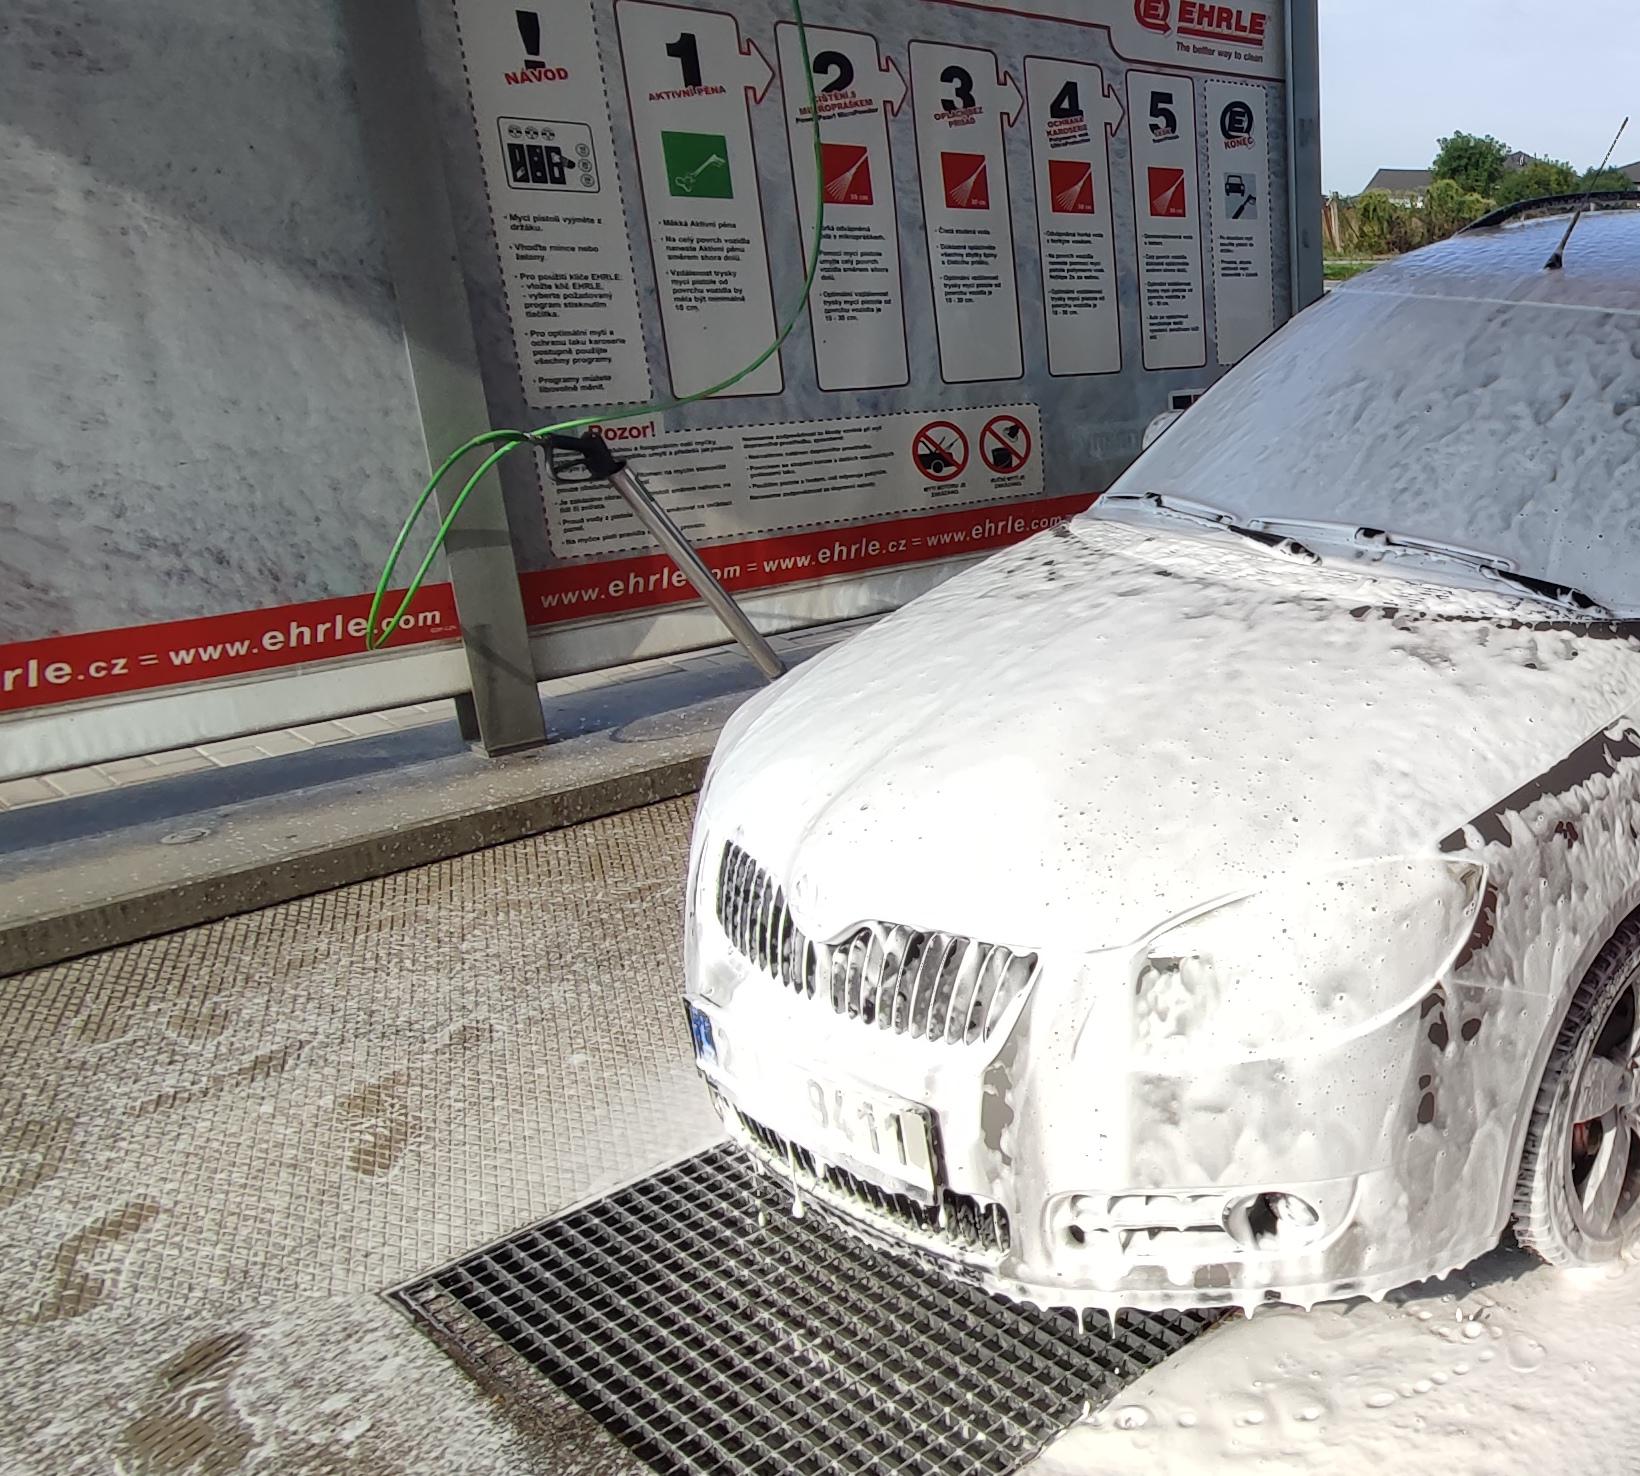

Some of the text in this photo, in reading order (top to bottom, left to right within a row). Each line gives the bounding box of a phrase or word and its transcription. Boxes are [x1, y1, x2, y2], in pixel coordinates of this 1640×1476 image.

[1178, 0, 1266, 36] EHRLE
[666, 32, 702, 88] 1
[1176, 41, 1191, 53] The
[813, 51, 854, 92] 2
[940, 65, 977, 112] 3
[1050, 80, 1085, 119] 4
[1149, 91, 1177, 136] 5
[763, 539, 908, 573] www.ehrle.cz
[927, 515, 1063, 555] www.ehrle.com
[169, 609, 441, 667] www.ehrle.com
